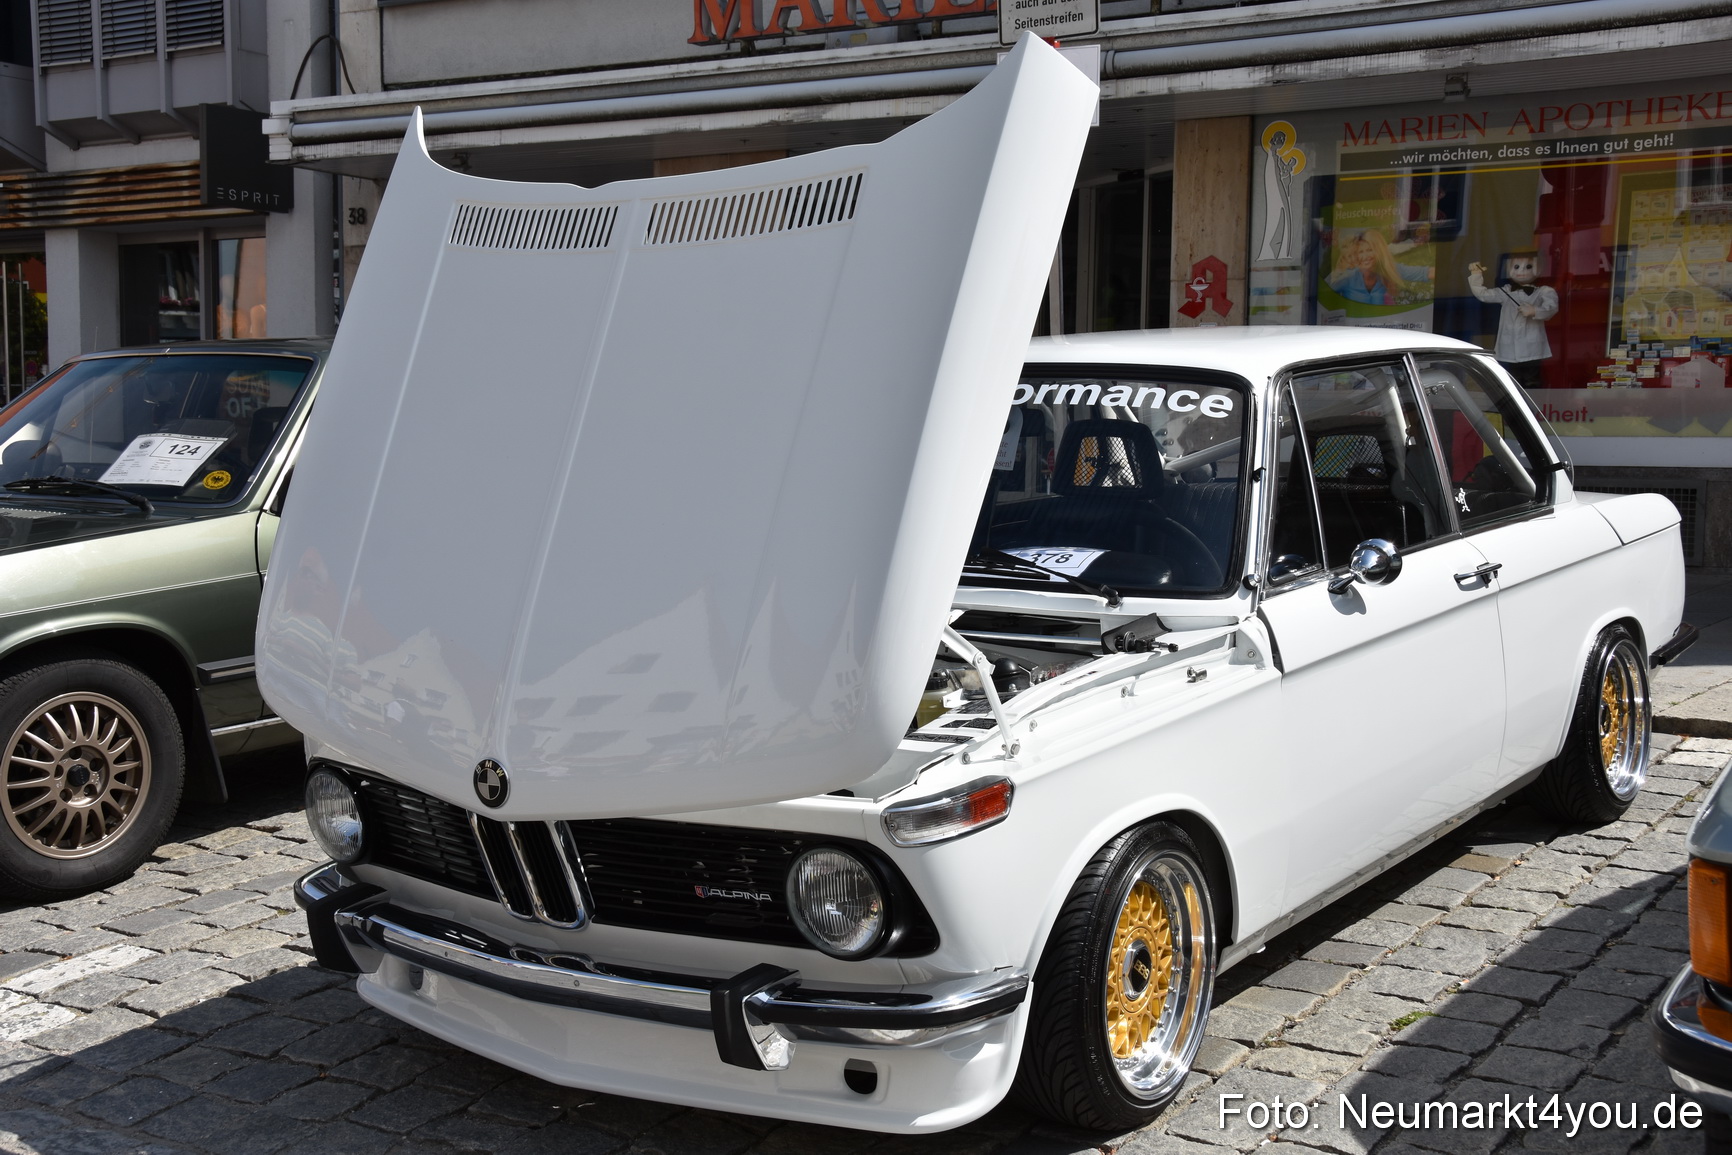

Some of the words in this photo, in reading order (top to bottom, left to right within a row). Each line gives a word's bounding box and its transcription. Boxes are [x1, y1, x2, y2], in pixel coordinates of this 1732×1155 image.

[1014, 12, 1084, 30] Seitenstreifen
[1342, 111, 1489, 147] MARIEN
[1507, 91, 1732, 135] APOTHEKE
[1429, 147, 1493, 162] möchten,
[1498, 145, 1530, 158] dass
[1535, 144, 1551, 155] es
[1556, 142, 1598, 154] Ihnen
[1603, 138, 1629, 154] gut
[1633, 133, 1674, 151] geht!
[217, 187, 280, 206] ESPRIT
[348, 207, 367, 226] 38
[168, 443, 201, 456] 124
[1030, 553, 1074, 564] 378
[475, 760, 504, 777] BMW
[708, 888, 772, 902] ALPINA
